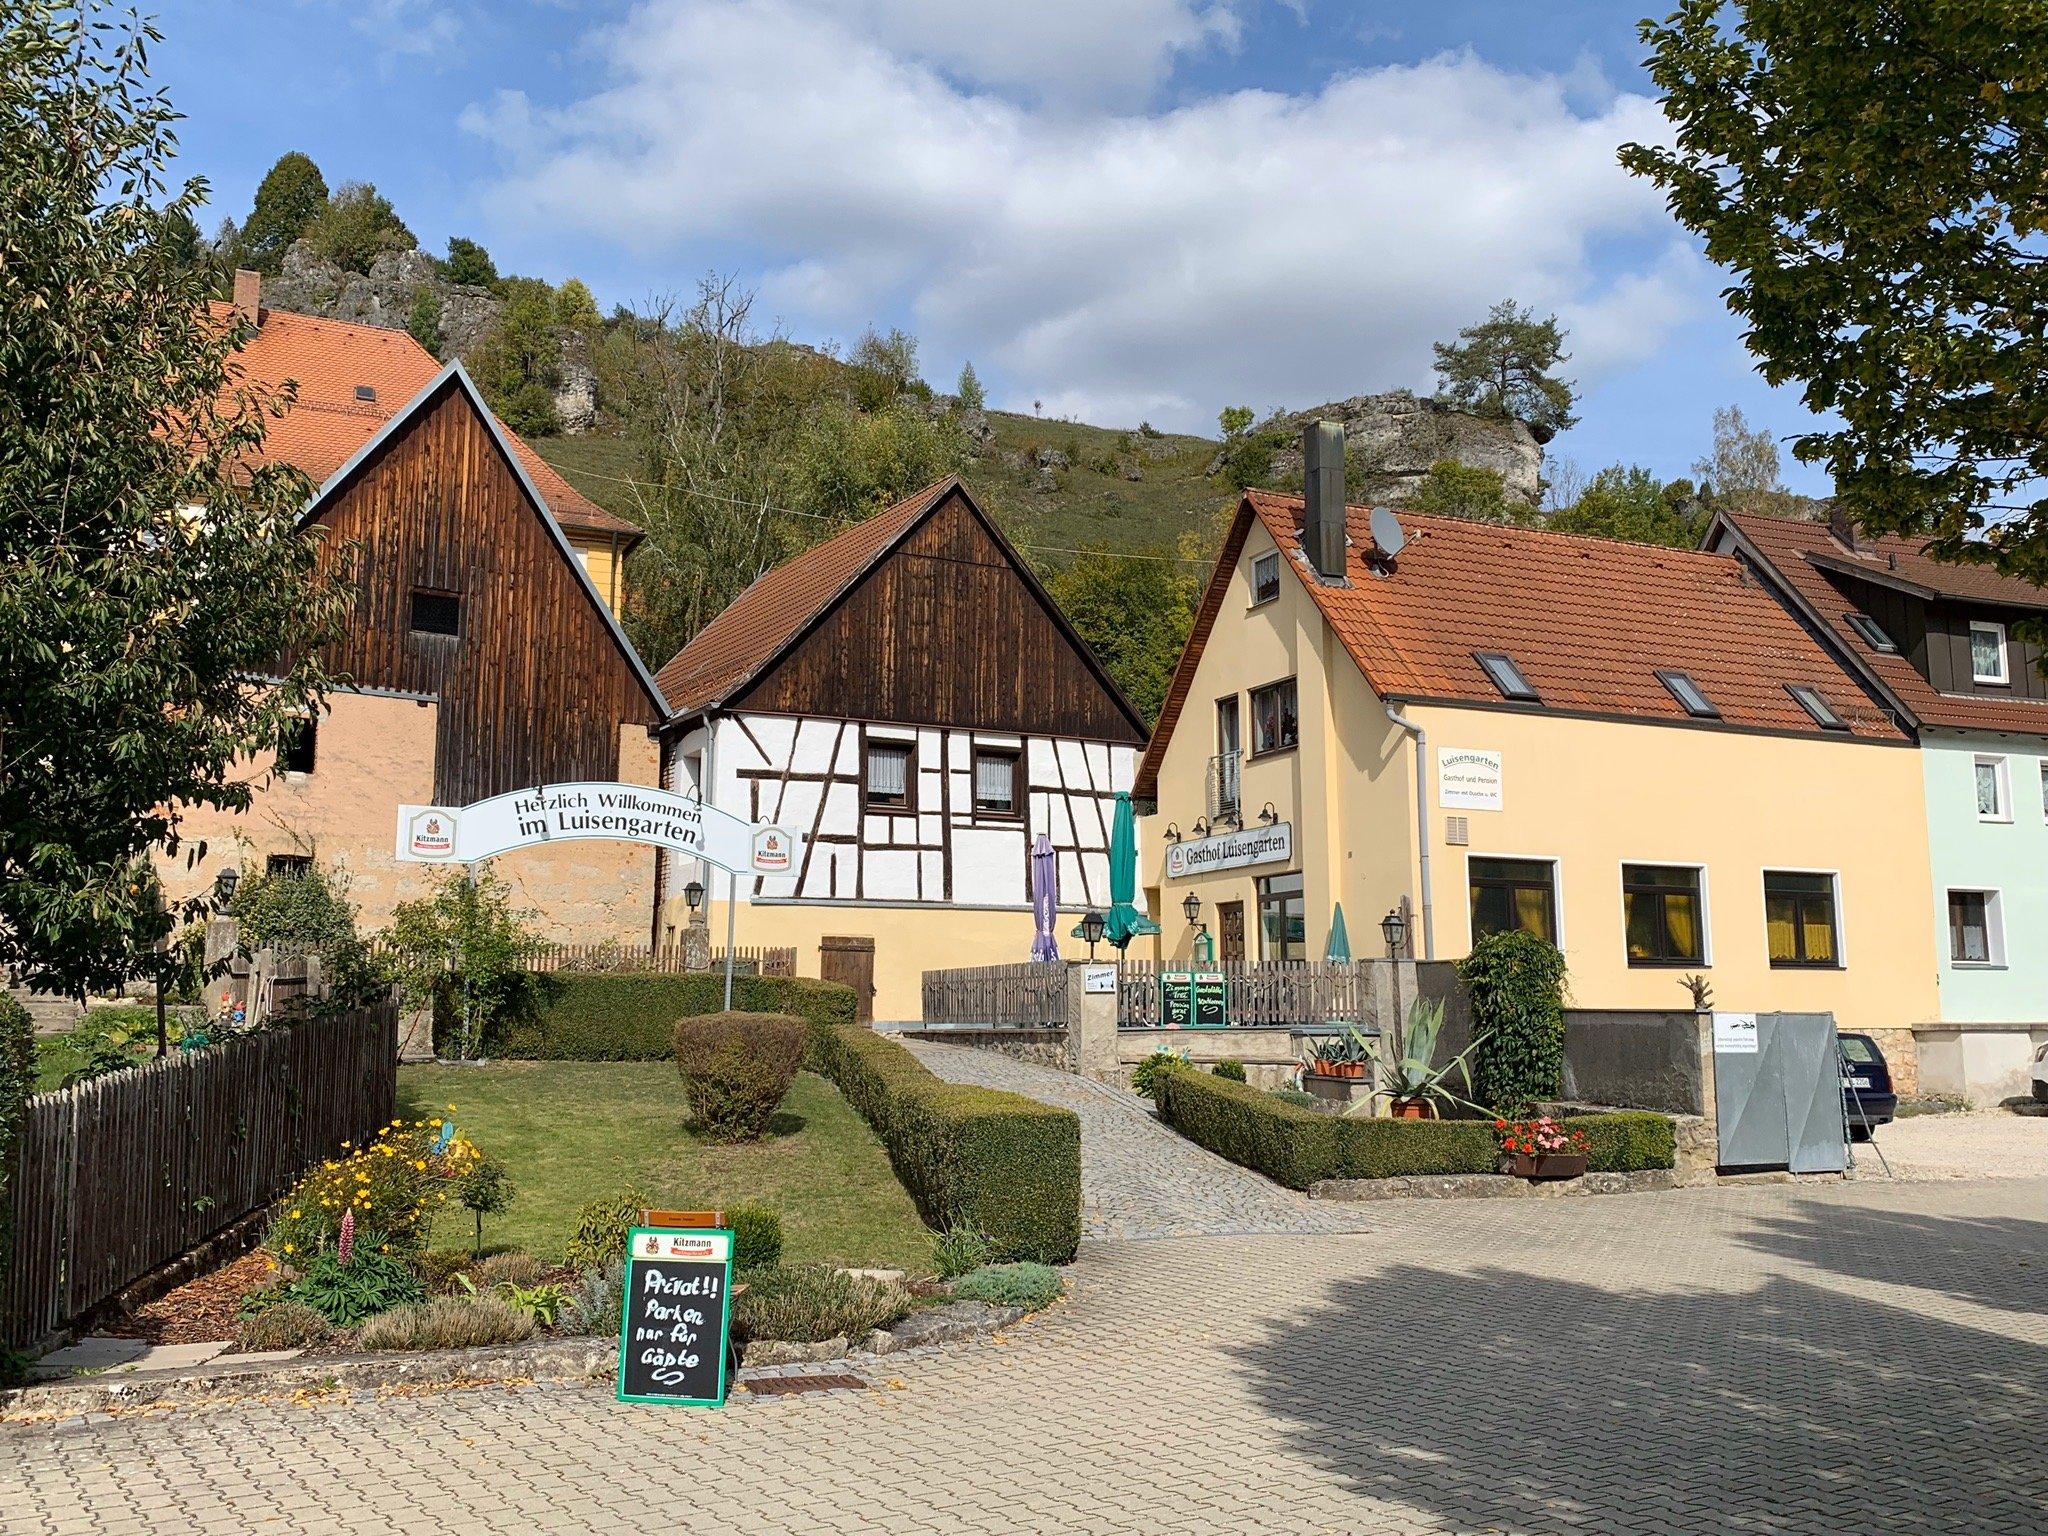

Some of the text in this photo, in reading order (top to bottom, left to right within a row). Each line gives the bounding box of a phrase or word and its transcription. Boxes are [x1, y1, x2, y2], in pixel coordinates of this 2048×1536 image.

[1441, 755, 1499, 769] Luisengarten
[1443, 774, 1465, 782] Gasthof
[515, 793, 702, 824] Herzlich Willkommen
[518, 809, 696, 844] im Luisengarten
[416, 834, 449, 843] Kitzmann
[757, 850, 787, 858] Kitzmann
[1186, 836, 1285, 865] Gasthof Luisengarten
[1087, 970, 1114, 981] Zimmer
[673, 1237, 712, 1248] Kitzmann
[644, 1269, 718, 1299] Privat!!
[644, 1298, 706, 1325] Parken
[635, 1322, 698, 1347] nur für
[641, 1347, 700, 1369] Gäste
